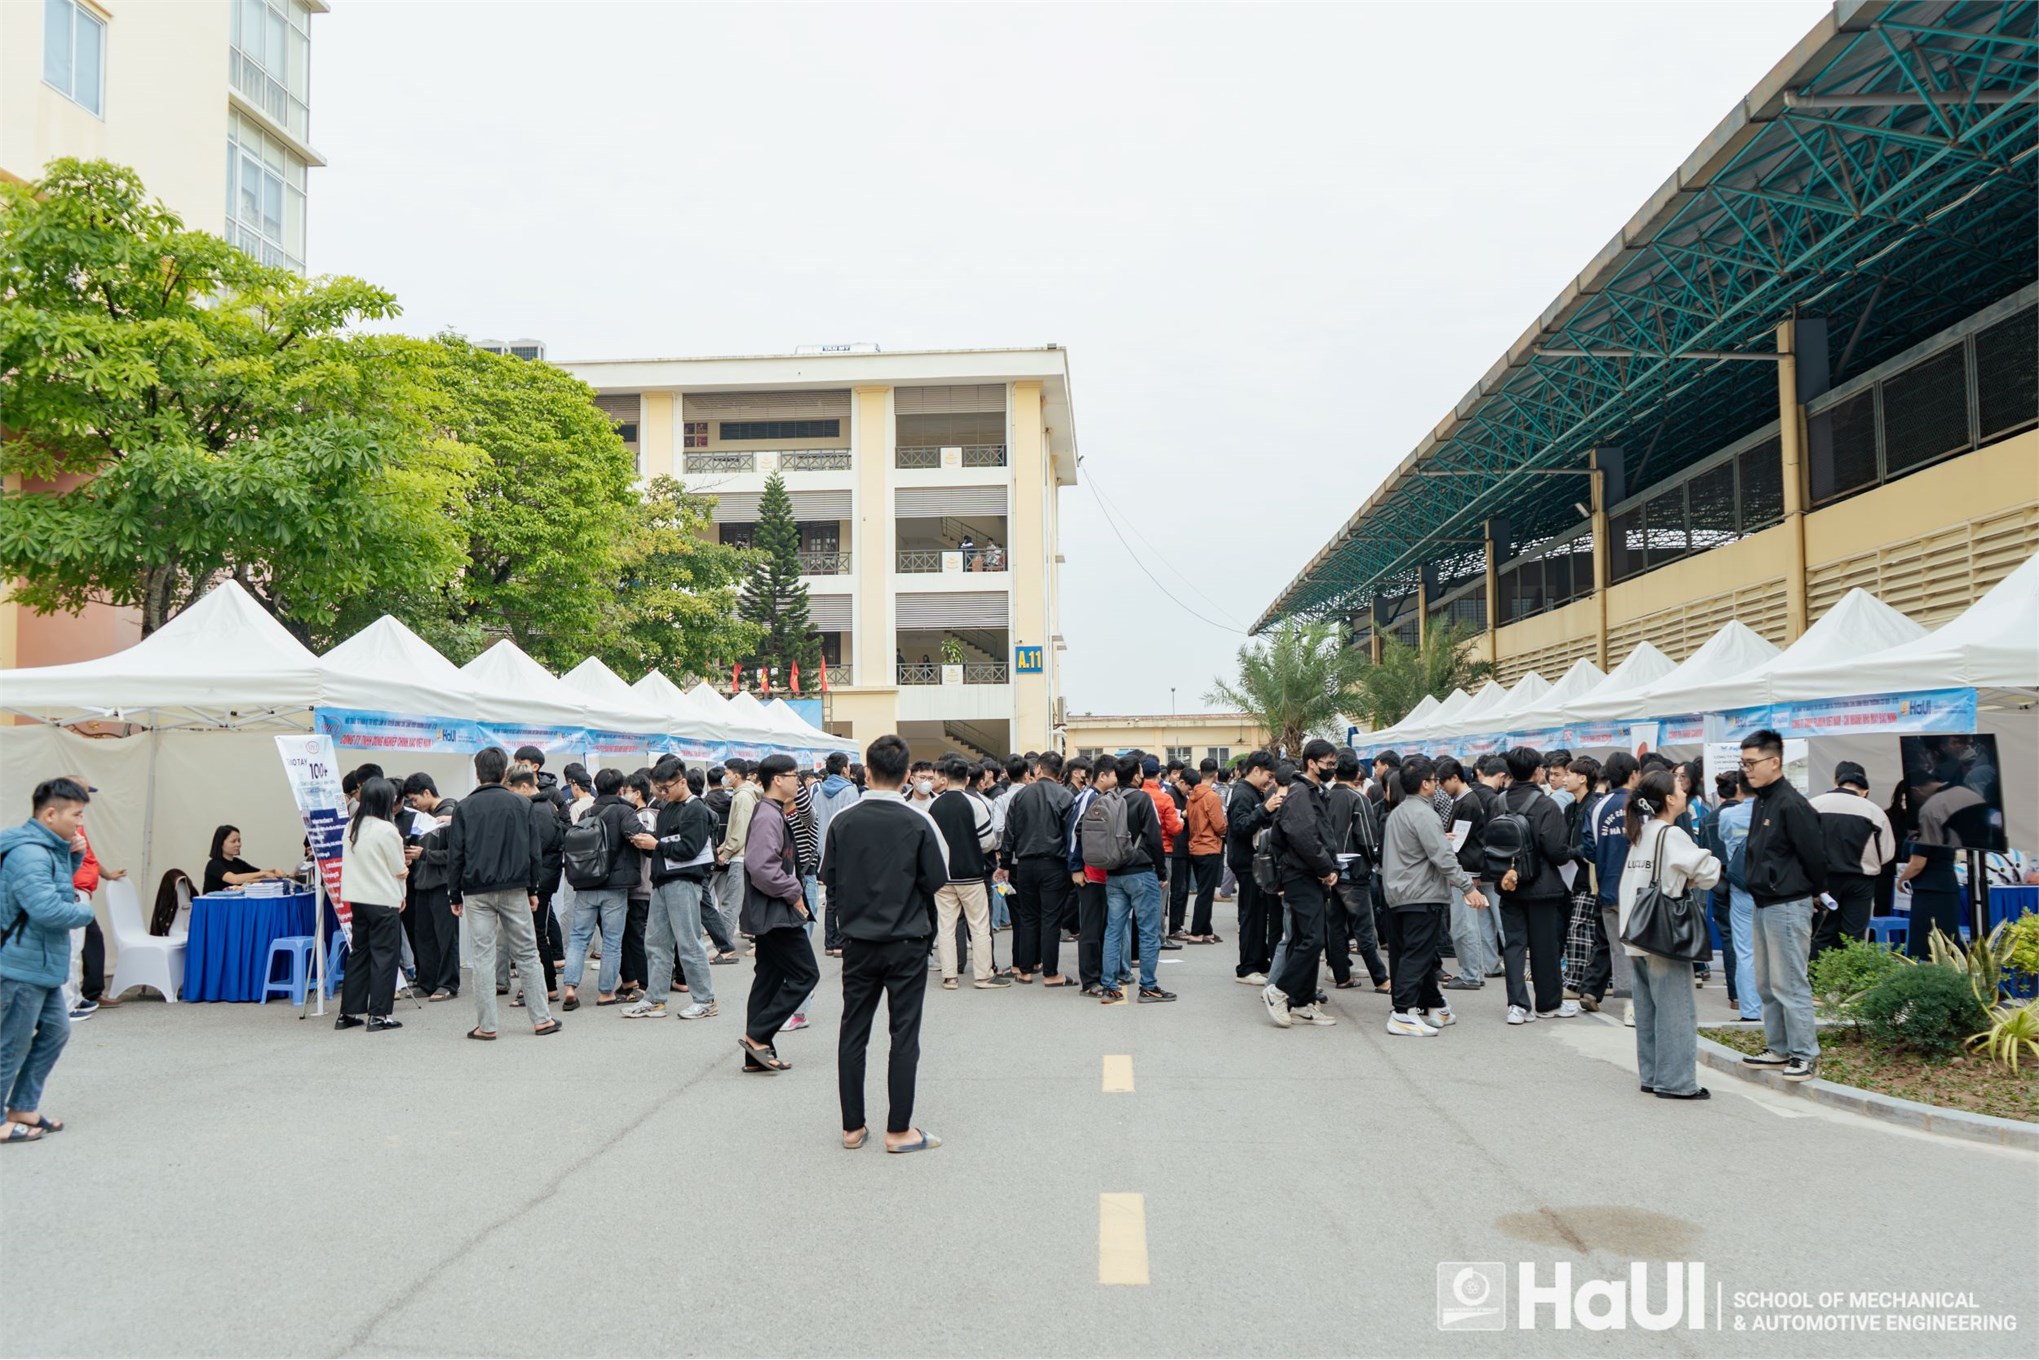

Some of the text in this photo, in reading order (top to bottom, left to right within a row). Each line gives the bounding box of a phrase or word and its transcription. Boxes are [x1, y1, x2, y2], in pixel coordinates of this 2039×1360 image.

[1018, 650, 1041, 668] A.11
[1909, 699, 1931, 716] HaUI
[442, 729, 456, 742] HaUI
[309, 763, 328, 779] 100+
